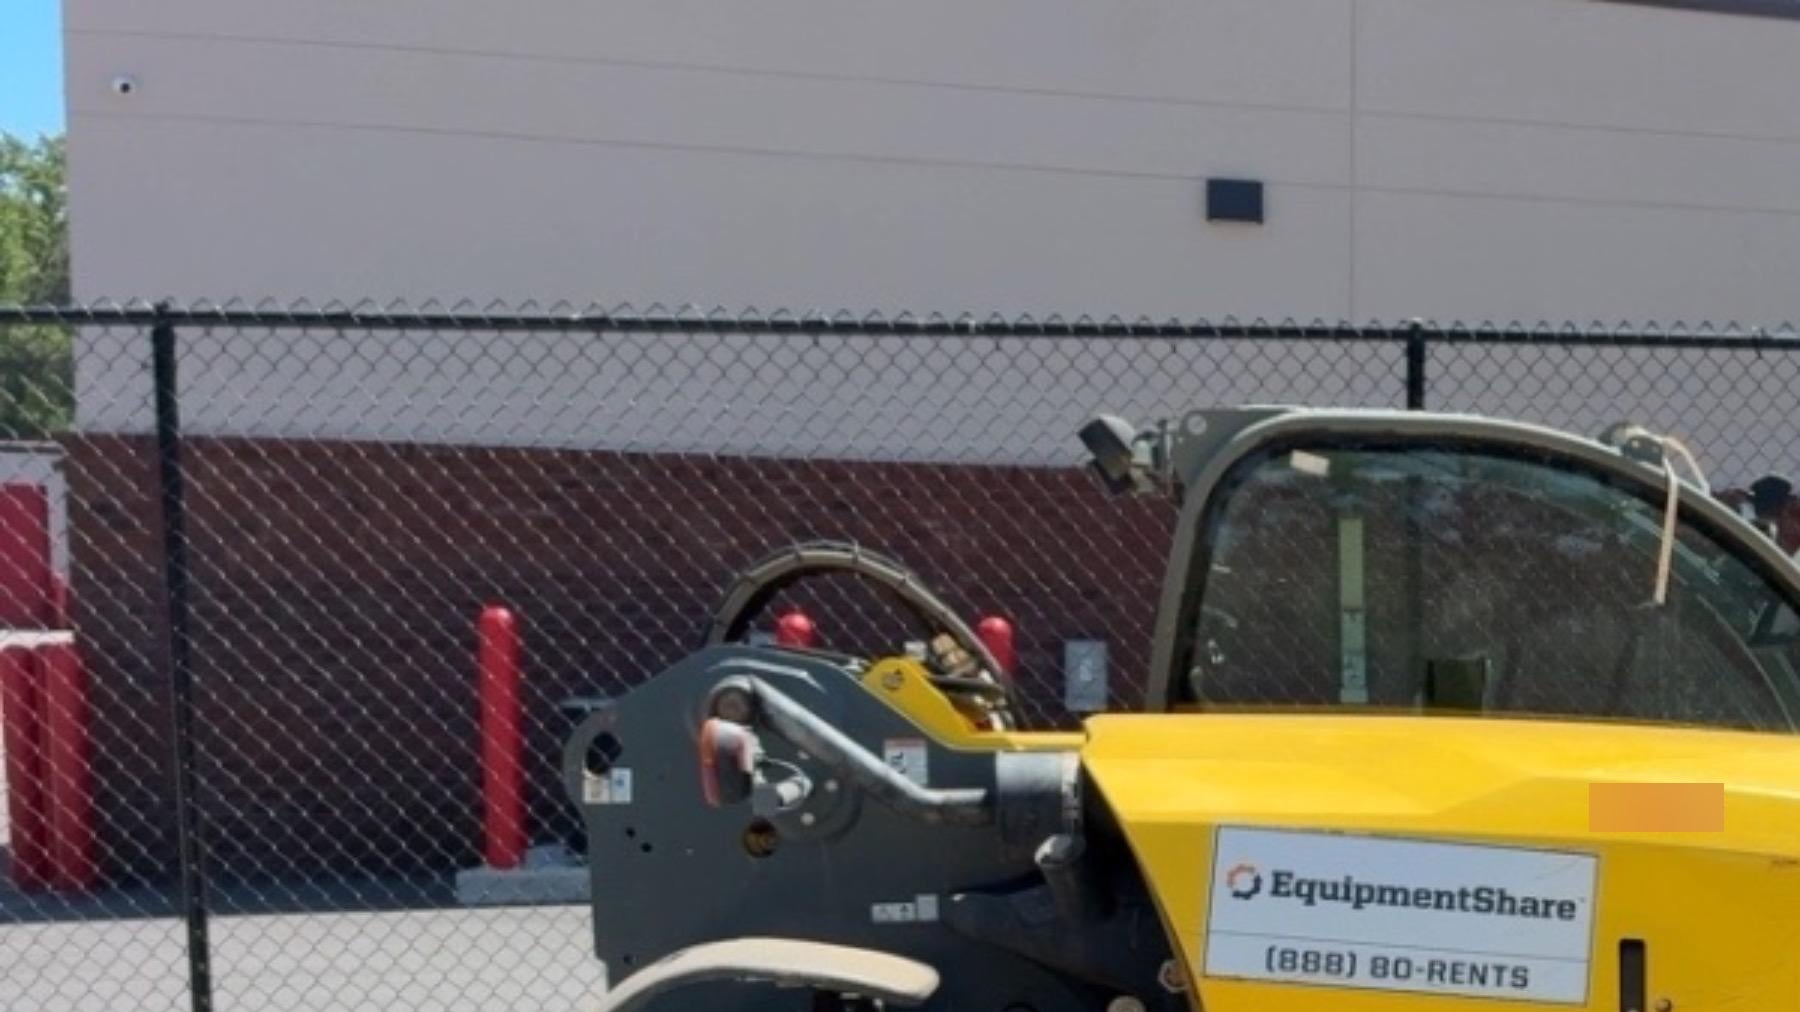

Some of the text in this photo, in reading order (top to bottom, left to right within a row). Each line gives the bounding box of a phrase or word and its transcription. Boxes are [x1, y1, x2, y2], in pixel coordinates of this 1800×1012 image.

[1270, 870, 1577, 921] EquipmentShare
[1265, 946, 1529, 989] (888) 80-RENTS
